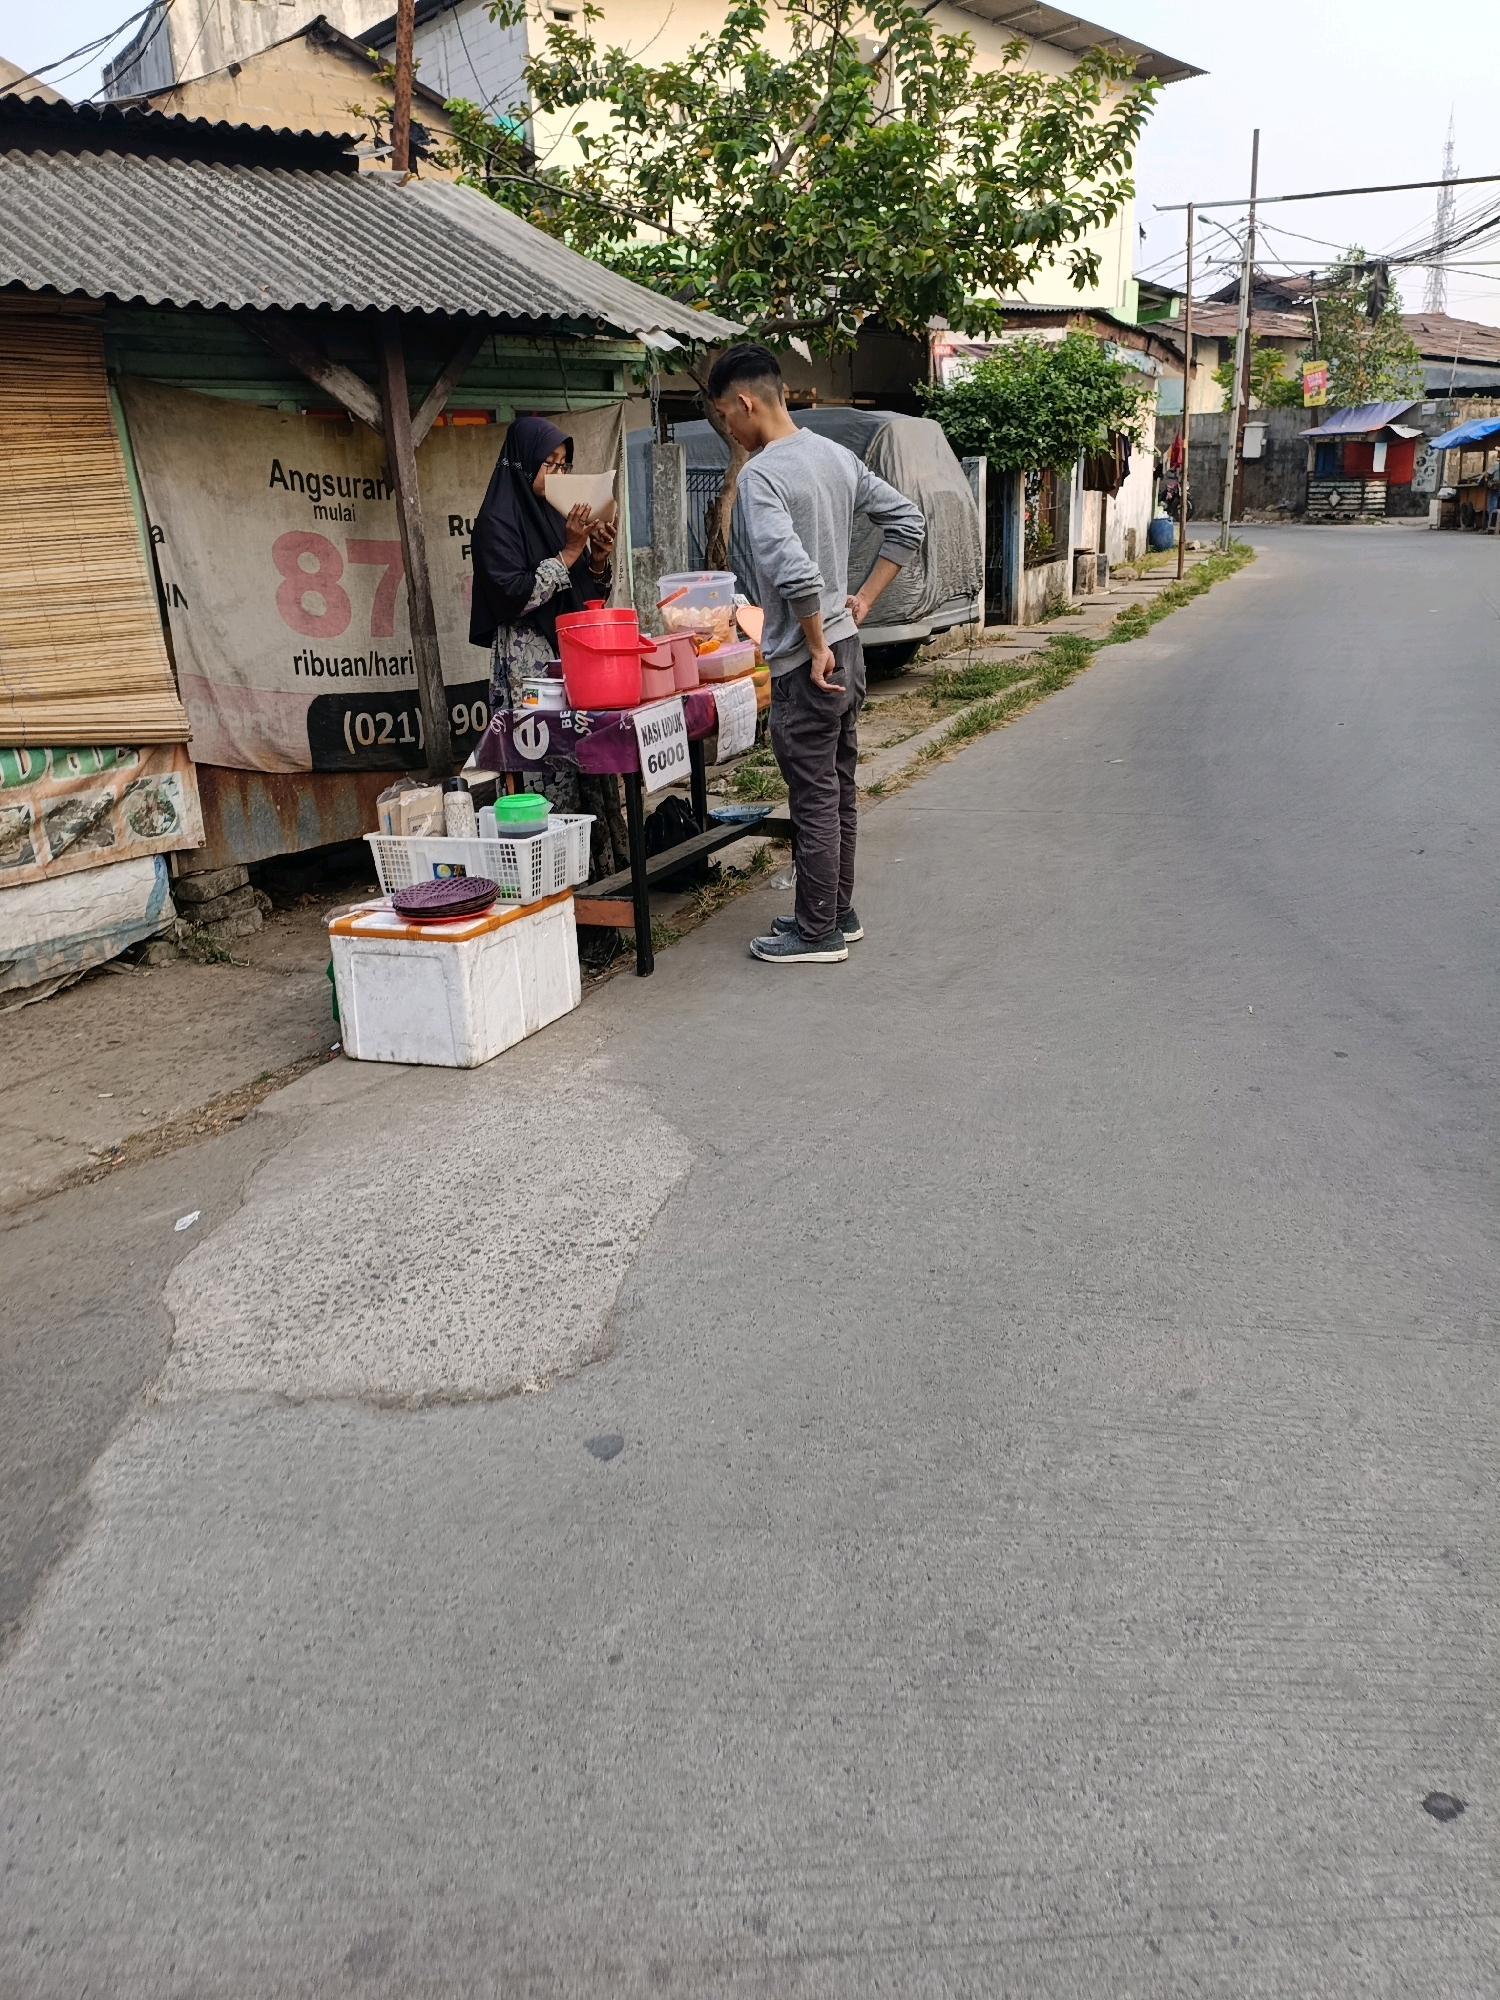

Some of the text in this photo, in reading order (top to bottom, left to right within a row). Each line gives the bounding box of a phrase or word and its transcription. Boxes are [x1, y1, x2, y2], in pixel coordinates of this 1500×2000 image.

[269, 459, 391, 502] Angsuran
[313, 502, 356, 522] mulai
[271, 530, 405, 639] 87
[293, 648, 415, 678] ribuan/hari
[344, 701, 488, 754] (021) 90
[640, 711, 685, 748] NASI UDUK
[647, 742, 685, 774] 6000
